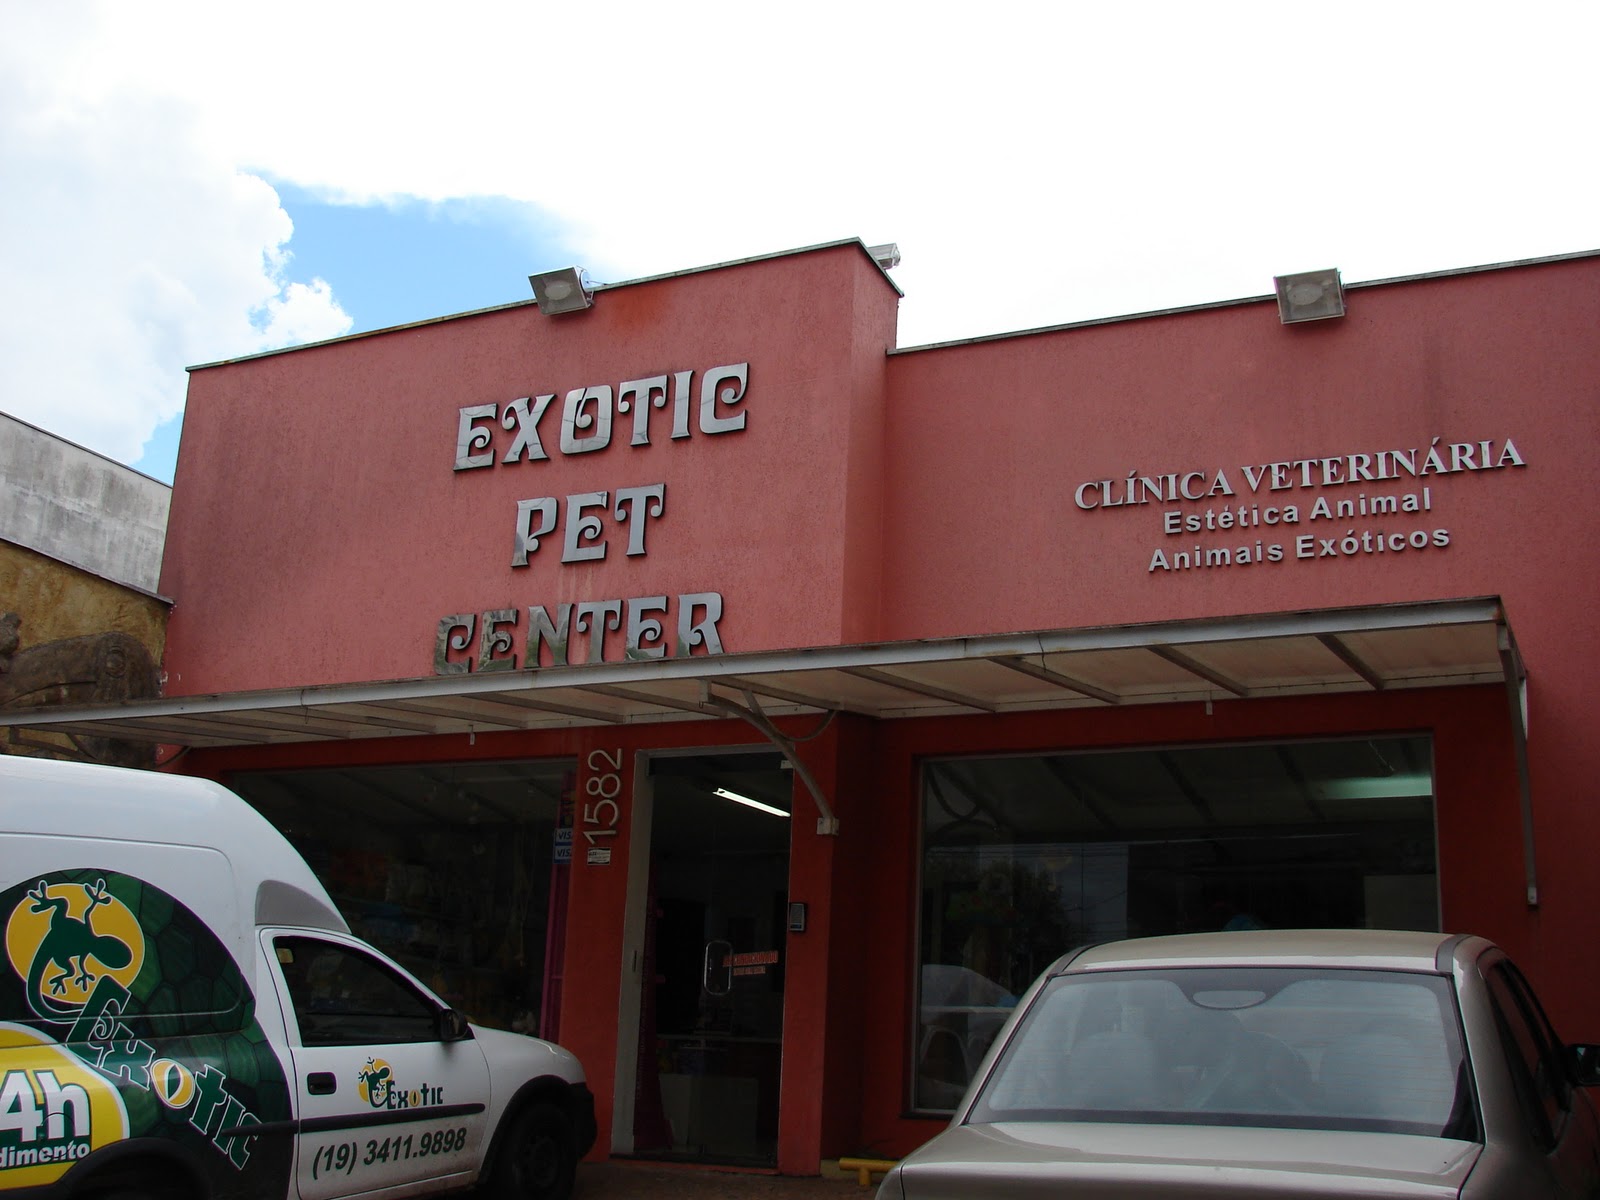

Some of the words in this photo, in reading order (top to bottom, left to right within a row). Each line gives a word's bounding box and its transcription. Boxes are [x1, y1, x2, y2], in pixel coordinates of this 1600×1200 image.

[453, 362, 748, 472] EXOTIC
[1074, 470, 1234, 510] CLÍNICA
[1241, 436, 1527, 493] VETERINÁRIA
[511, 483, 666, 568] PET
[1163, 504, 1300, 536] Estética
[1310, 487, 1432, 521] Animal
[1147, 540, 1284, 573] Animais
[1295, 527, 1451, 559] Exóticos
[433, 592, 724, 676] CENTER
[583, 748, 622, 845] 1582
[557, 848, 572, 858] VIS
[558, 831, 572, 841] VIS
[313, 1142, 357, 1180] (19)
[364, 1127, 467, 1166] 3411.9898
